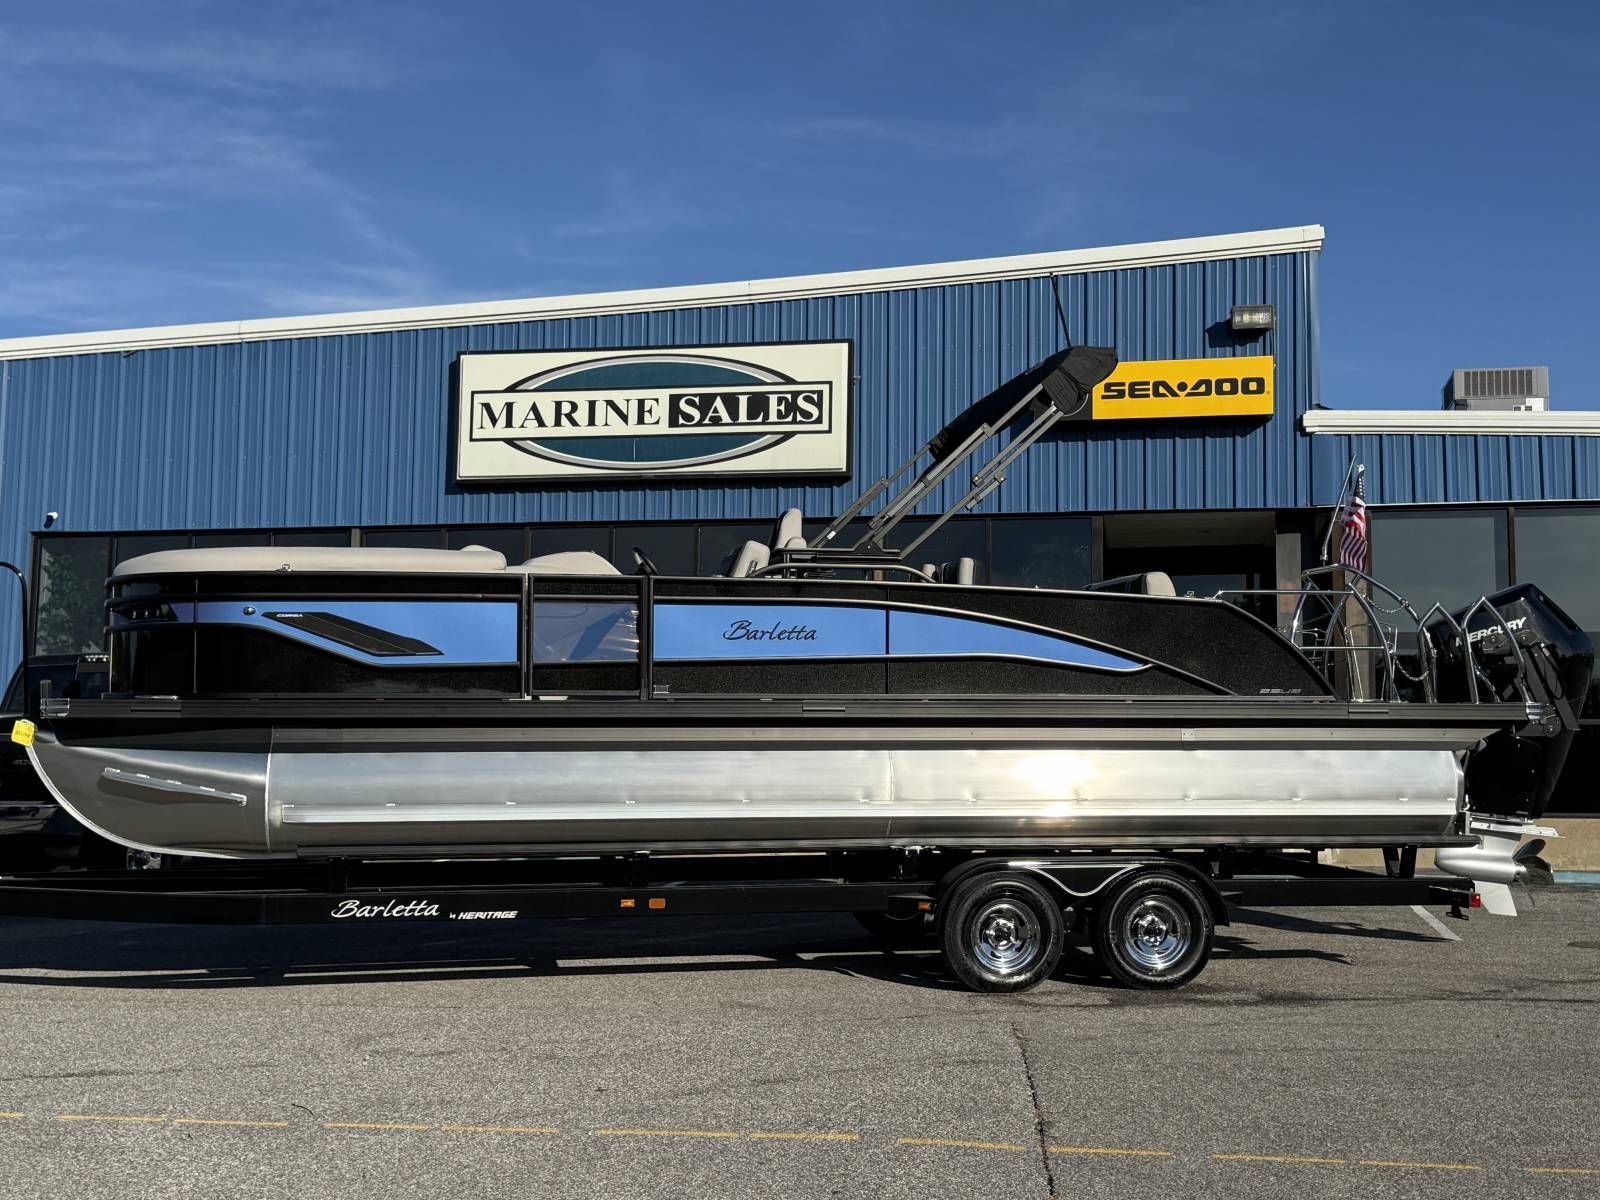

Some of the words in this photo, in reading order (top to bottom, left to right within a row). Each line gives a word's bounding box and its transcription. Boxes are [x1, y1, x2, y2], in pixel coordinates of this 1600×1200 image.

[477, 397, 661, 430] MARINE
[678, 392, 820, 426] SALES
[722, 619, 818, 641] Barletta
[330, 899, 440, 919] Barletta
[457, 910, 519, 920] HERITAGE
